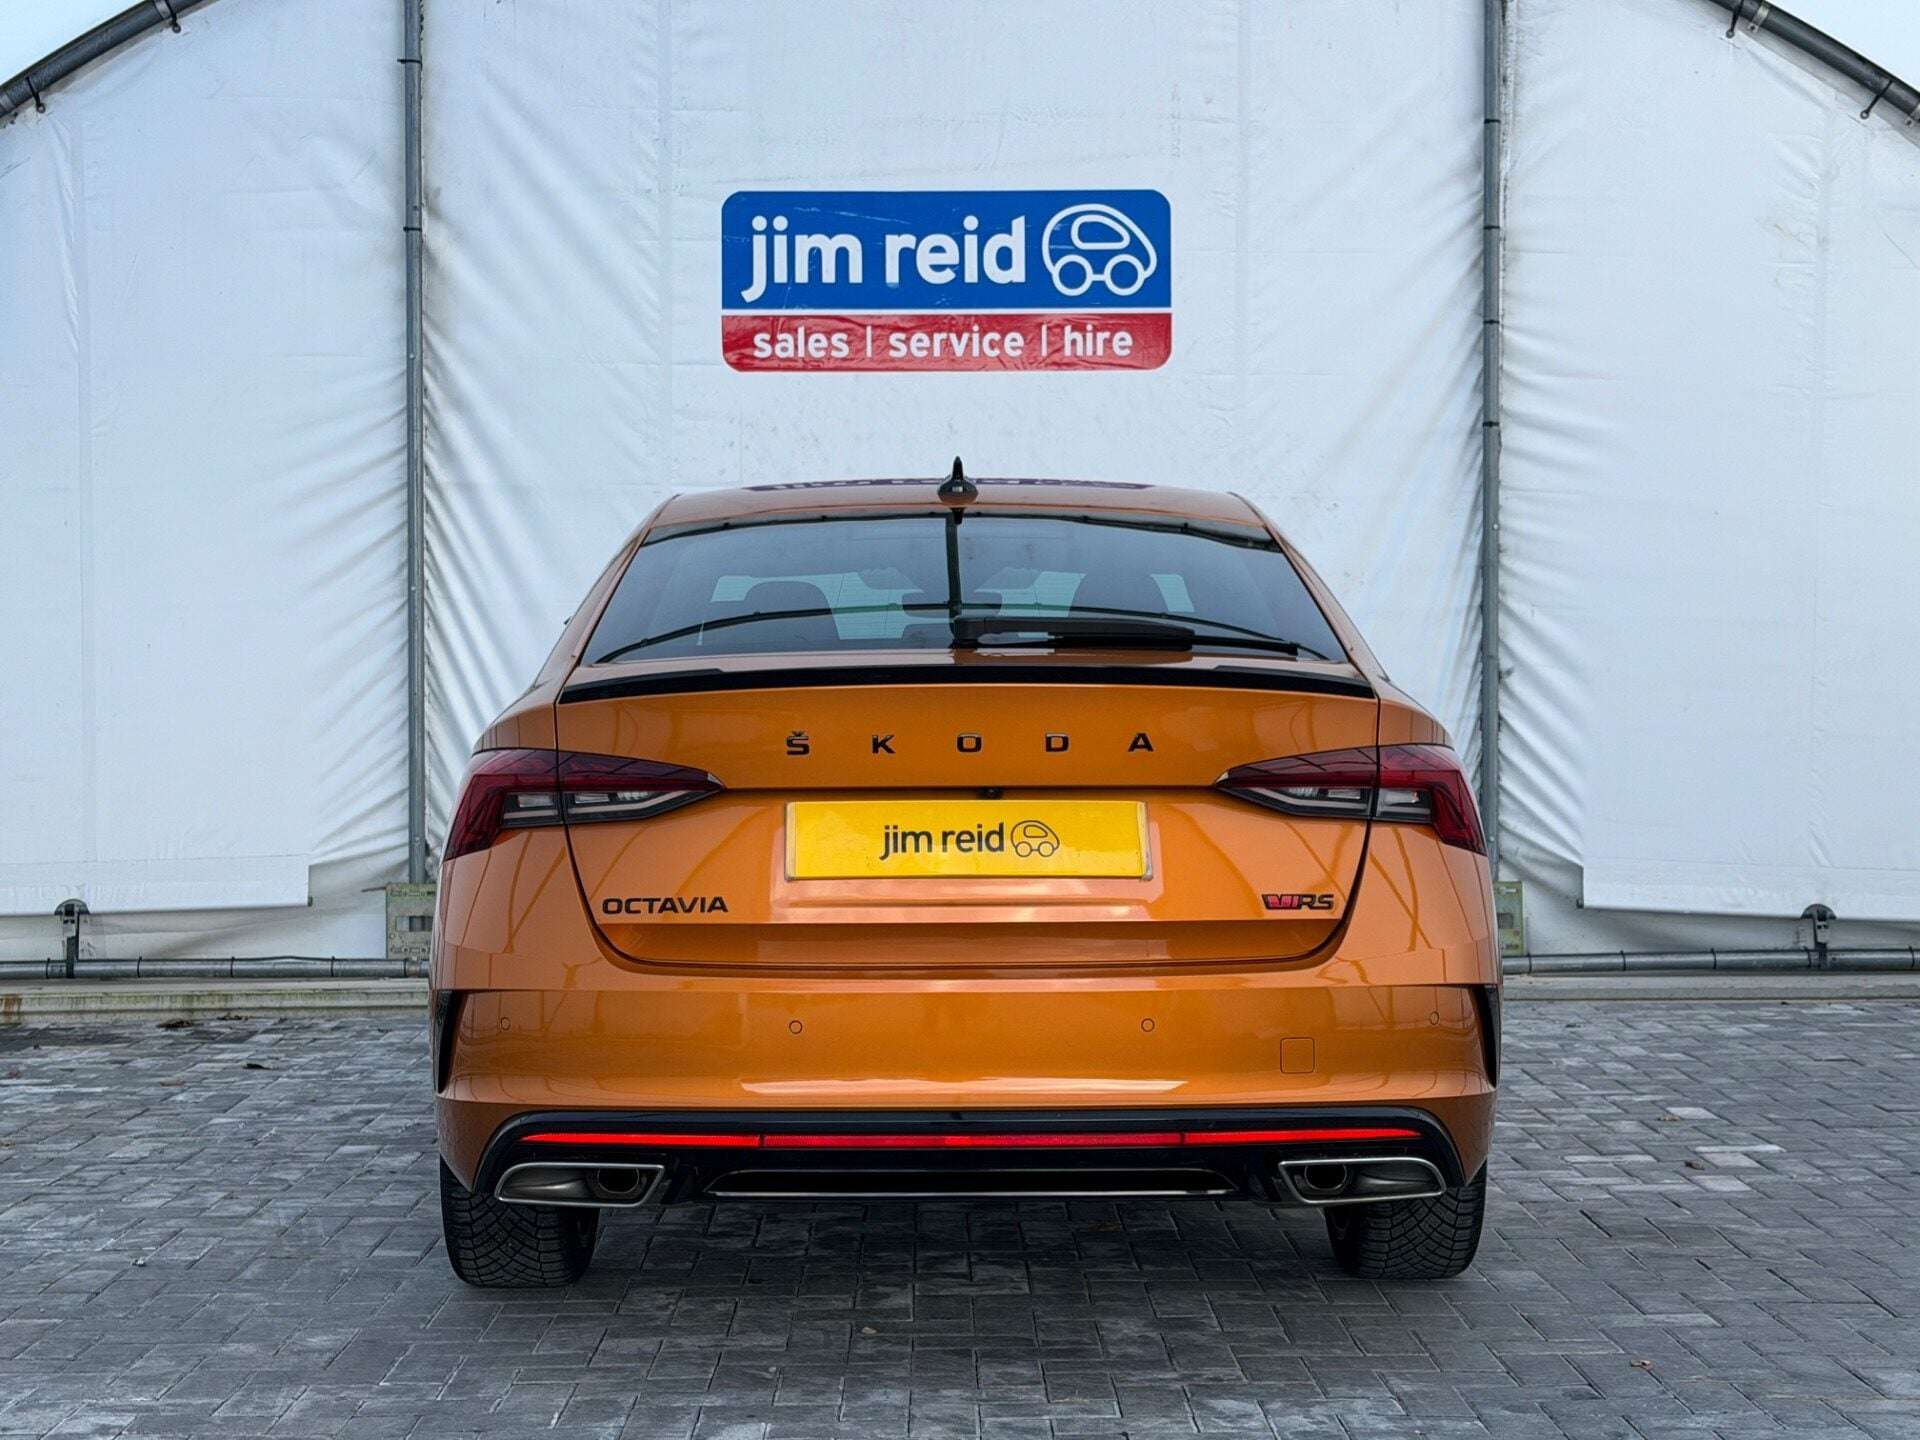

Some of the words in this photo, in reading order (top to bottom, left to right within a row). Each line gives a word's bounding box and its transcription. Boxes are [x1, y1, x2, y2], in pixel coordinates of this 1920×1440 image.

[741, 215, 863, 303] jim
[885, 215, 1026, 284] reid
[752, 326, 850, 359] sales
[888, 325, 1024, 358] service
[1063, 324, 1133, 357] hire
[879, 824, 933, 861] jim
[942, 822, 1005, 853] reid
[601, 896, 729, 915] OCTAVIA
